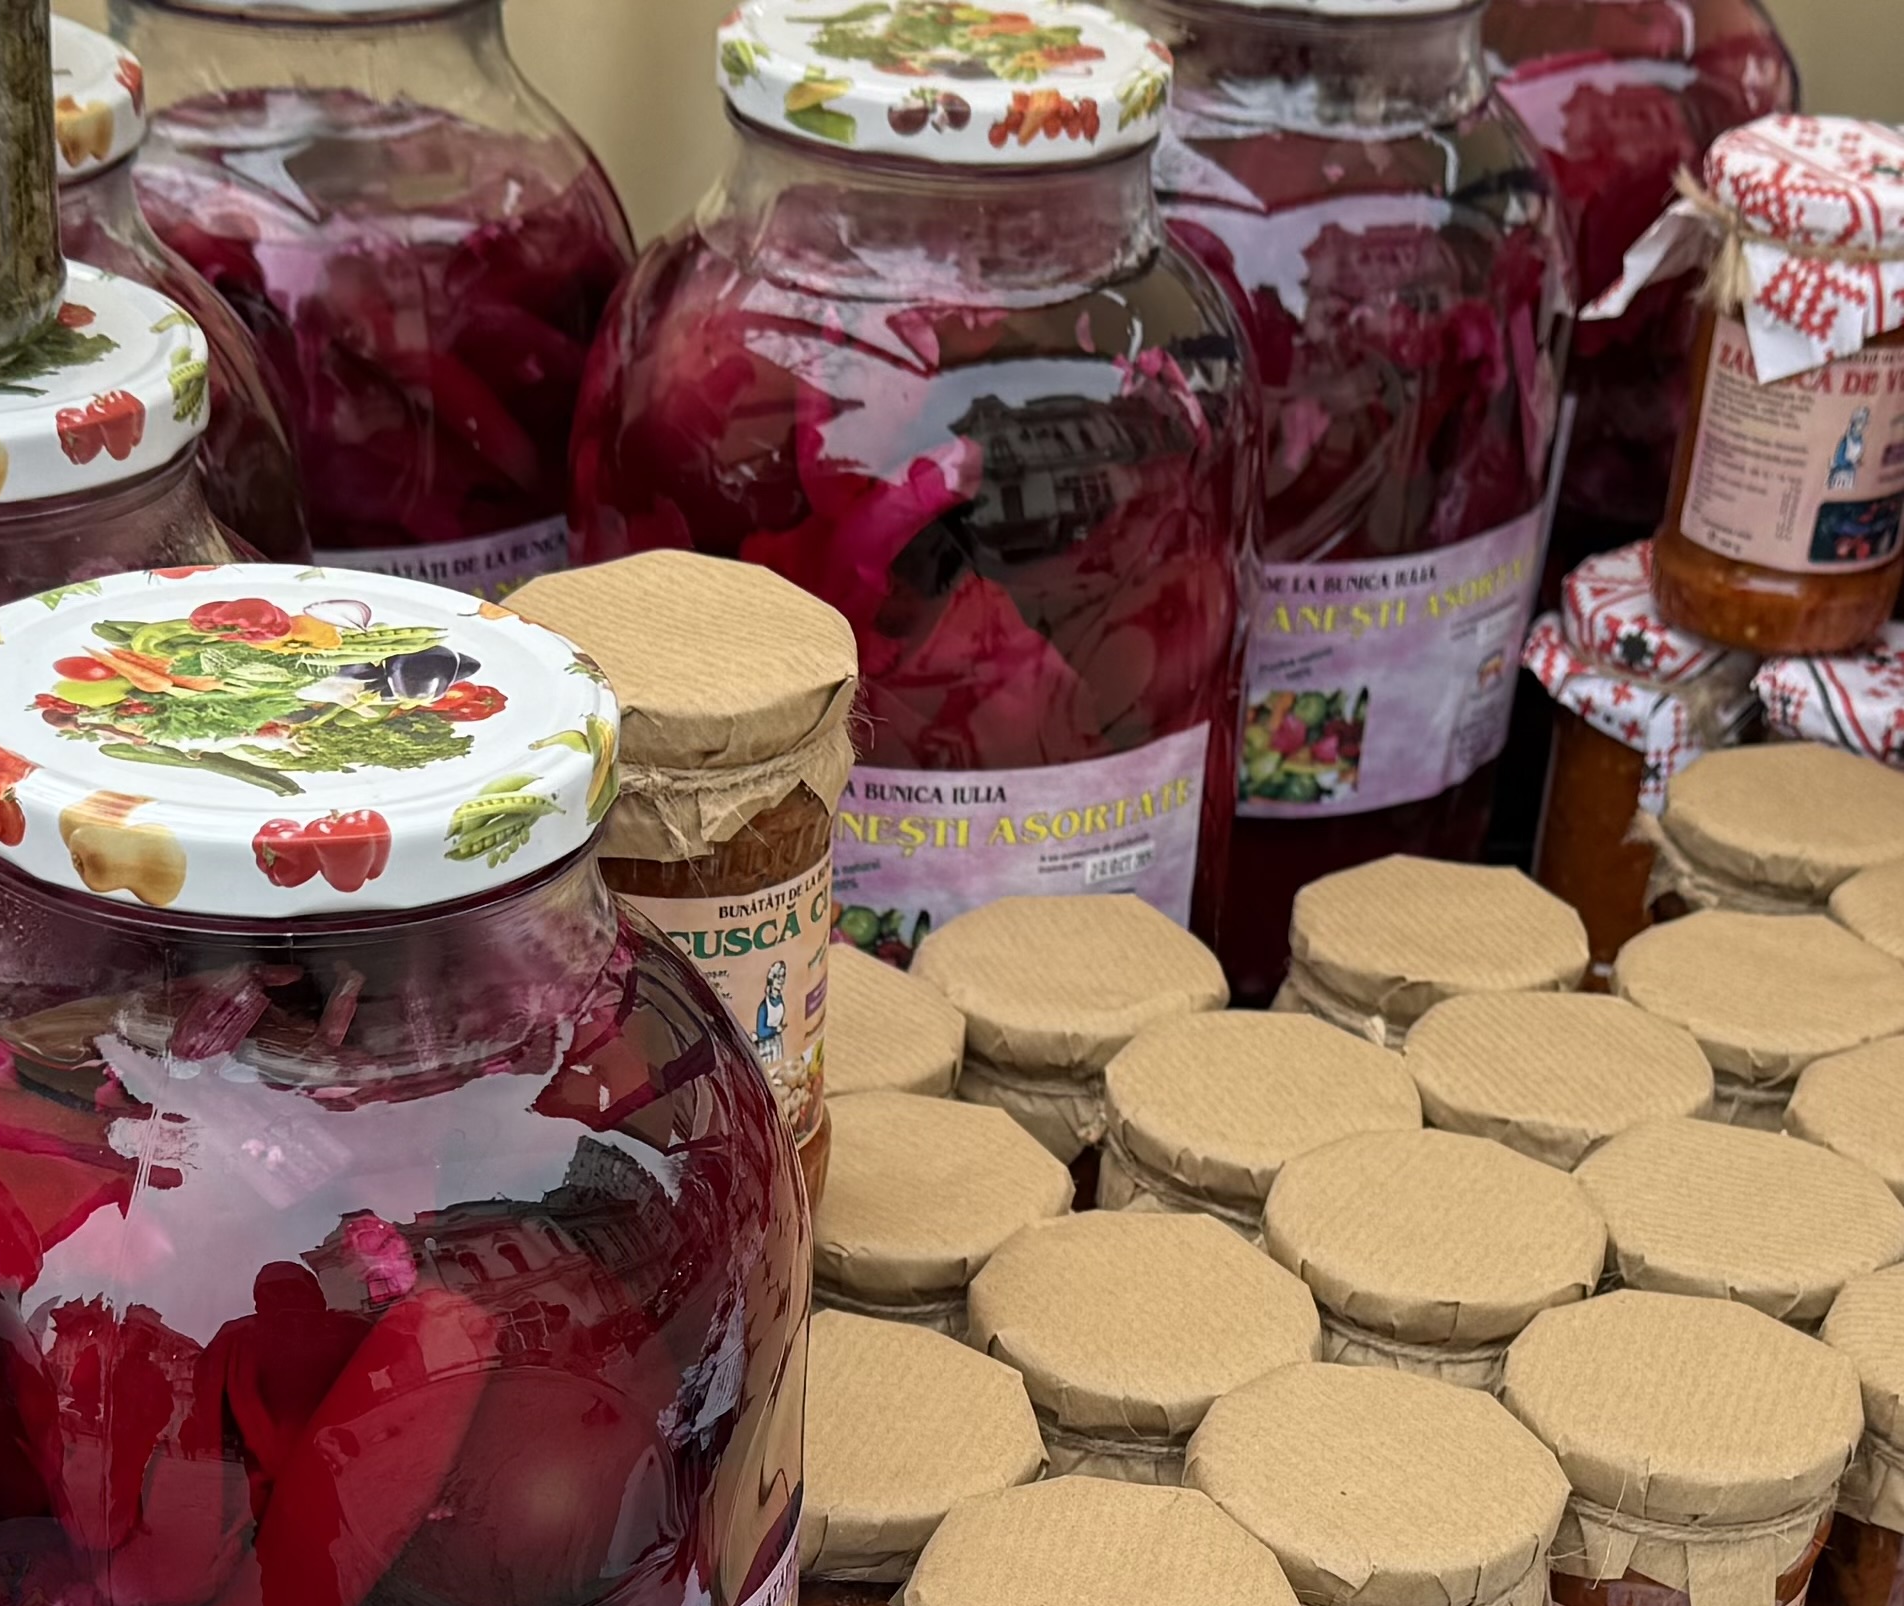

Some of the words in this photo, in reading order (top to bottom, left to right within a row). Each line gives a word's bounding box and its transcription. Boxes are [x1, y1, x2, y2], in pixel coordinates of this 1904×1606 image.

[864, 782, 944, 806] BUNICA
[952, 784, 1007, 805] IULIA
[718, 890, 786, 921] BUNĂTĂȚI
